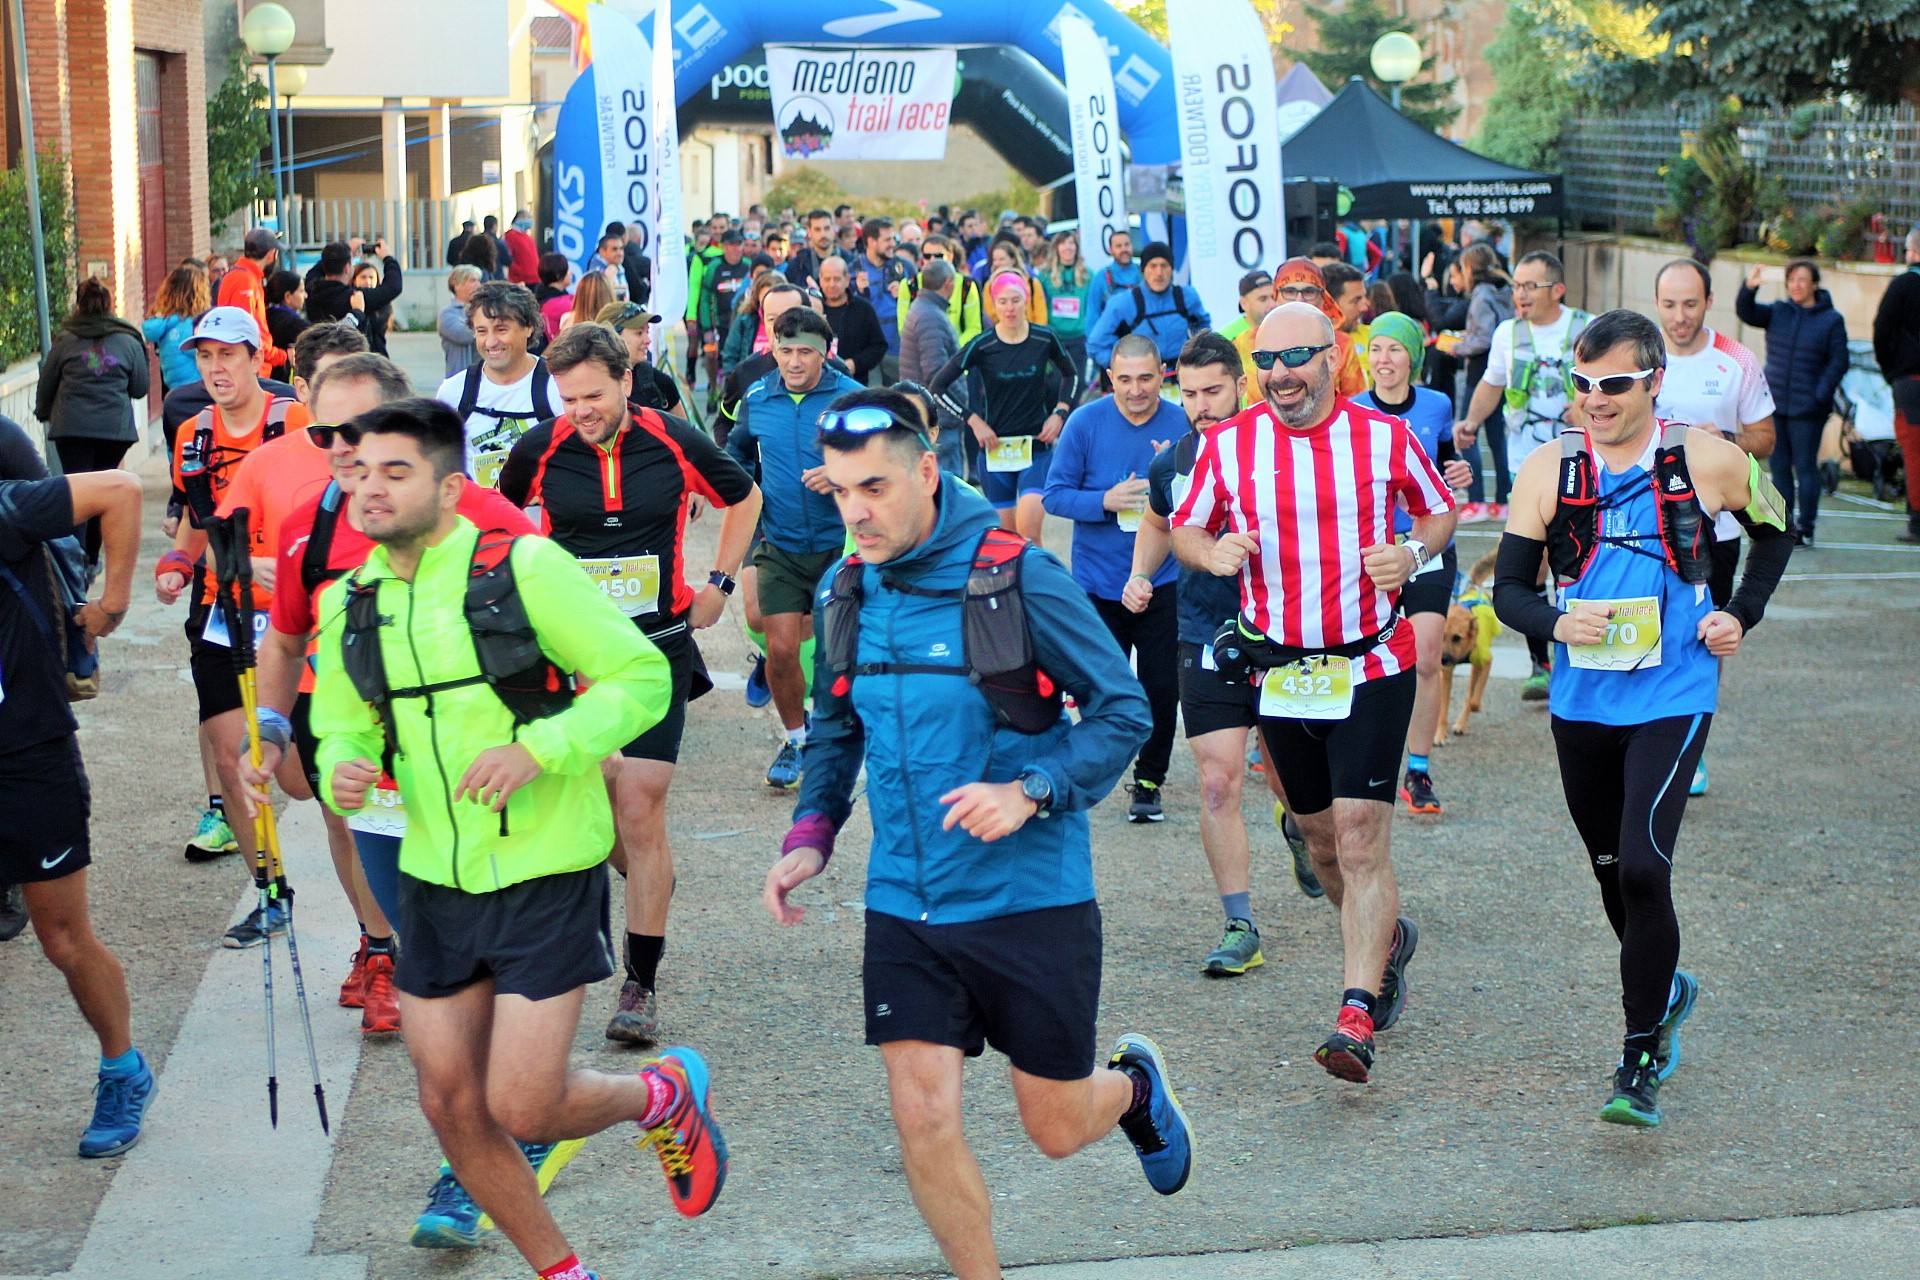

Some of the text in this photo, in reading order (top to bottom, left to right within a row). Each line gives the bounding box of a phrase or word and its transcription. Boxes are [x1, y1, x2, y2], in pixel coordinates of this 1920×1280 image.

[792, 49, 916, 95] medrano
[846, 96, 948, 132] trail race
[1409, 180, 1553, 199] www.podoactiva.com
[1455, 198, 1481, 215] 902
[1281, 675, 1333, 696] 432
